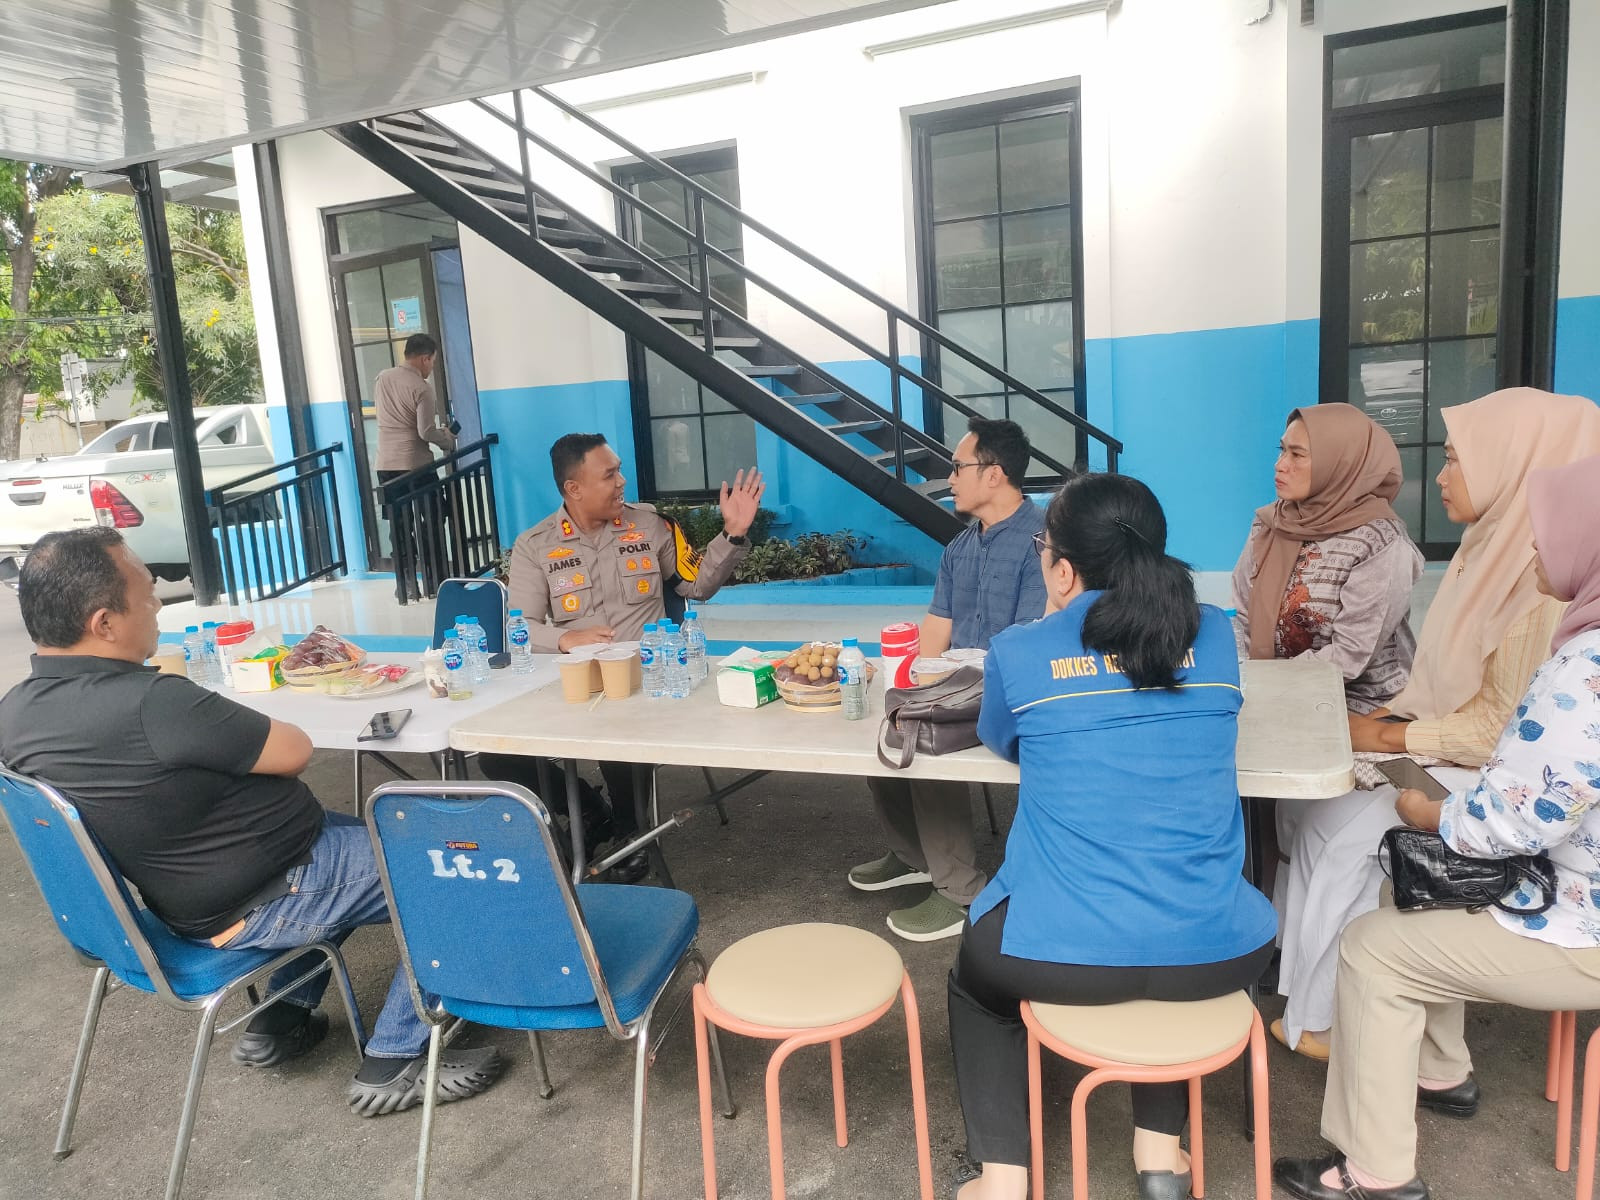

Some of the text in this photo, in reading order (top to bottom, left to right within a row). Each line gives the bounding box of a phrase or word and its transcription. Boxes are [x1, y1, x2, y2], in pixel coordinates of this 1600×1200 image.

[618, 542, 651, 555] POLRI
[549, 557, 582, 574] JAMES
[1050, 656, 1098, 679] DOKKES
[427, 850, 520, 883] Lt. 2
